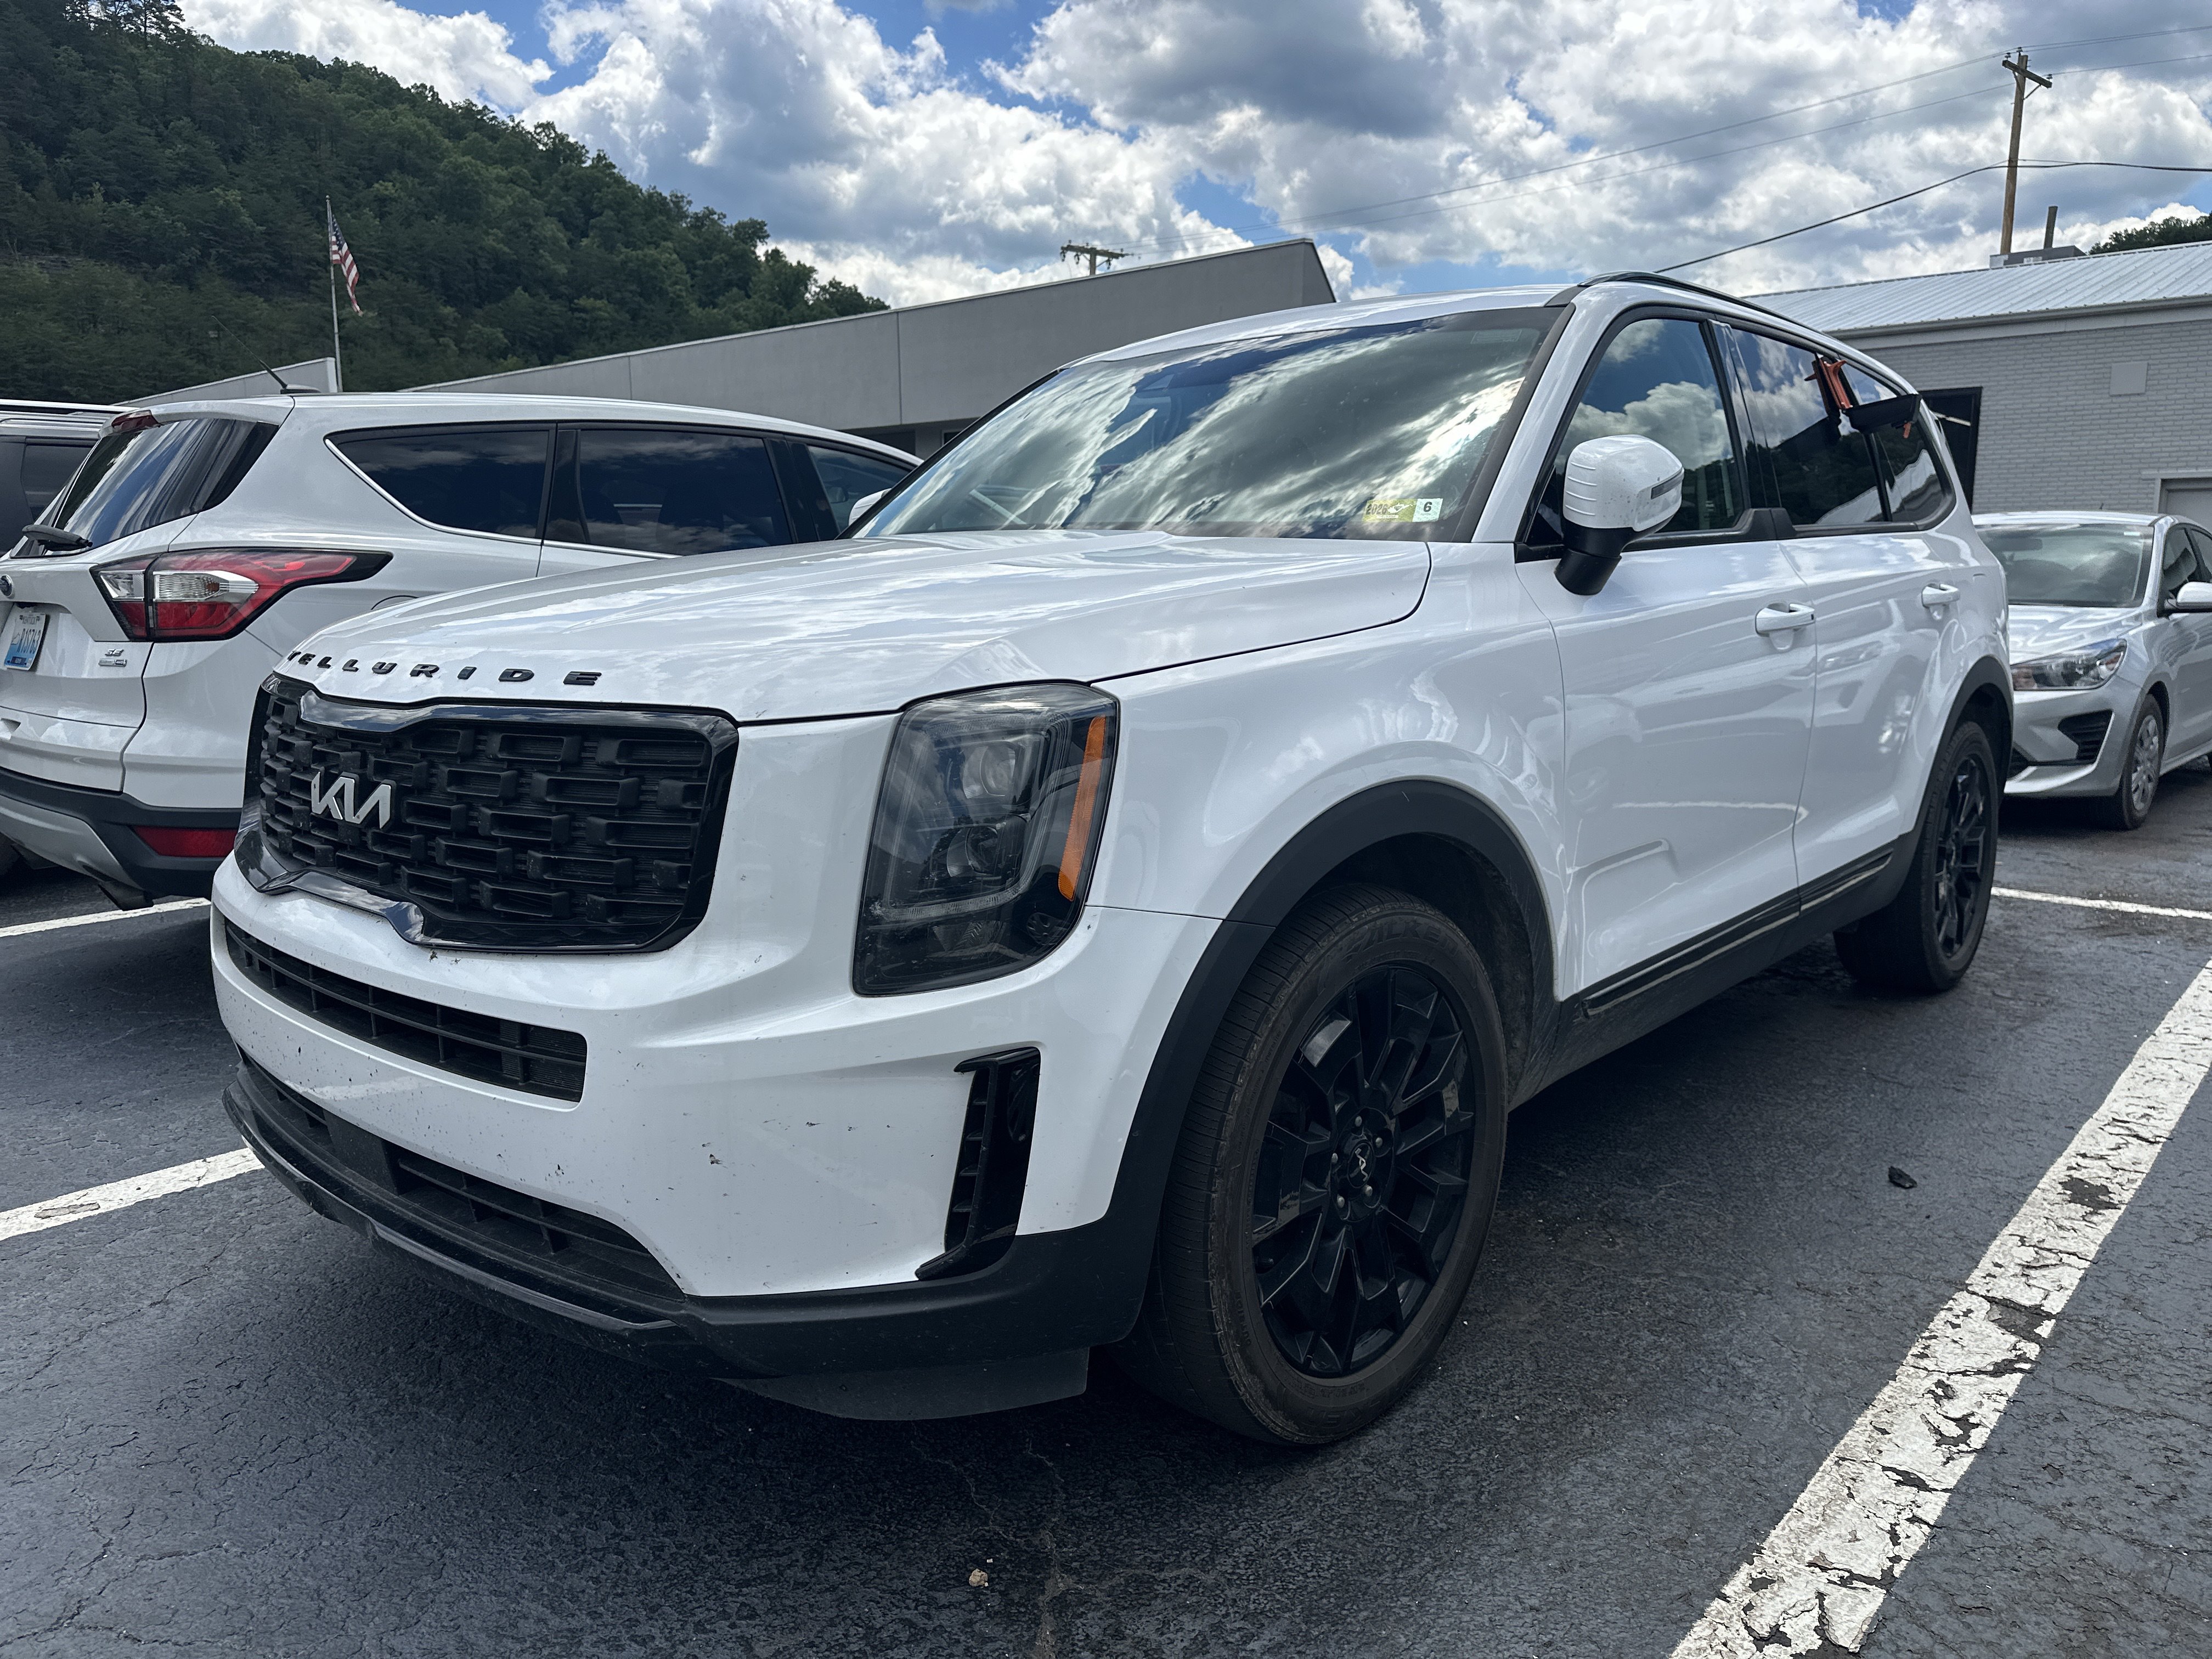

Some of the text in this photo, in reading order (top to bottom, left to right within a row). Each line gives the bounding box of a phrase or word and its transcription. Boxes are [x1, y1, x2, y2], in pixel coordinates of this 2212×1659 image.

[1365, 501, 1433, 515] 2026 6
[286, 651, 602, 686] TELLURIDE
